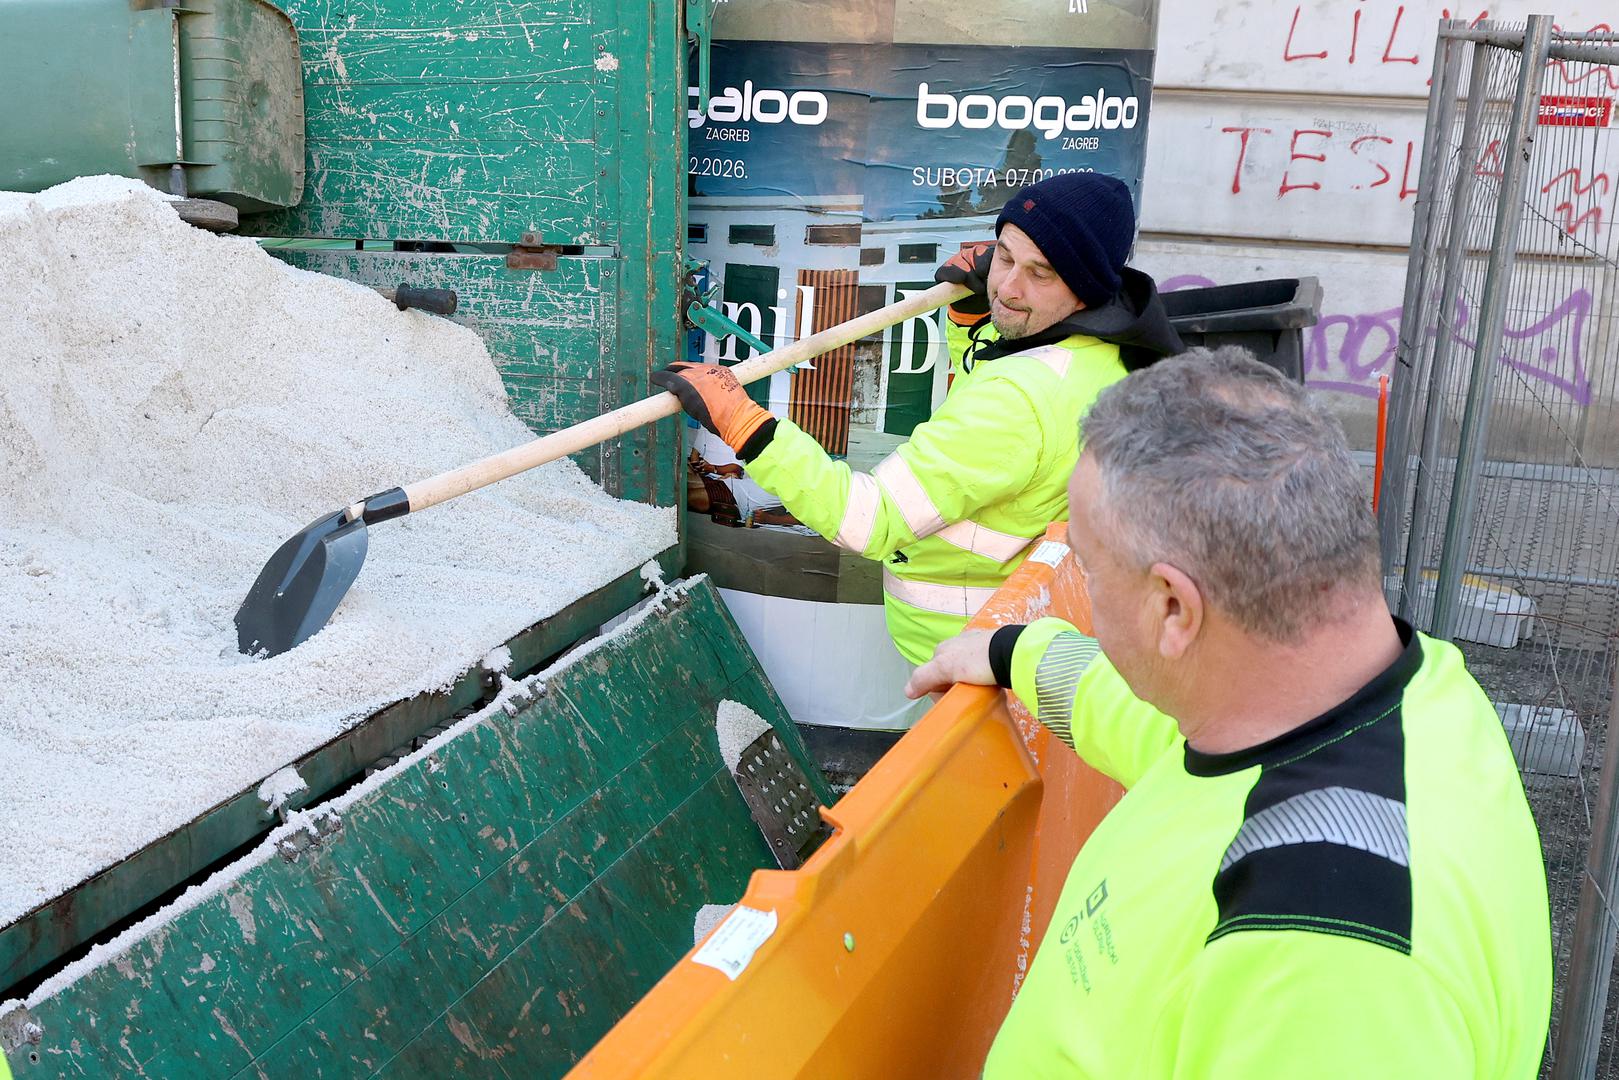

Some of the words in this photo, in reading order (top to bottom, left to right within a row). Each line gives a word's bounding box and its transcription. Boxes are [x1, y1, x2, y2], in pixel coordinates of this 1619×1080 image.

[688, 79, 828, 129] galoo
[917, 82, 1139, 140] boogaloo
[705, 127, 750, 142] ZAGREB
[1062, 137, 1099, 150] ZAGREB
[688, 156, 748, 179] 2.2026.
[912, 166, 997, 187] SUBOTA
